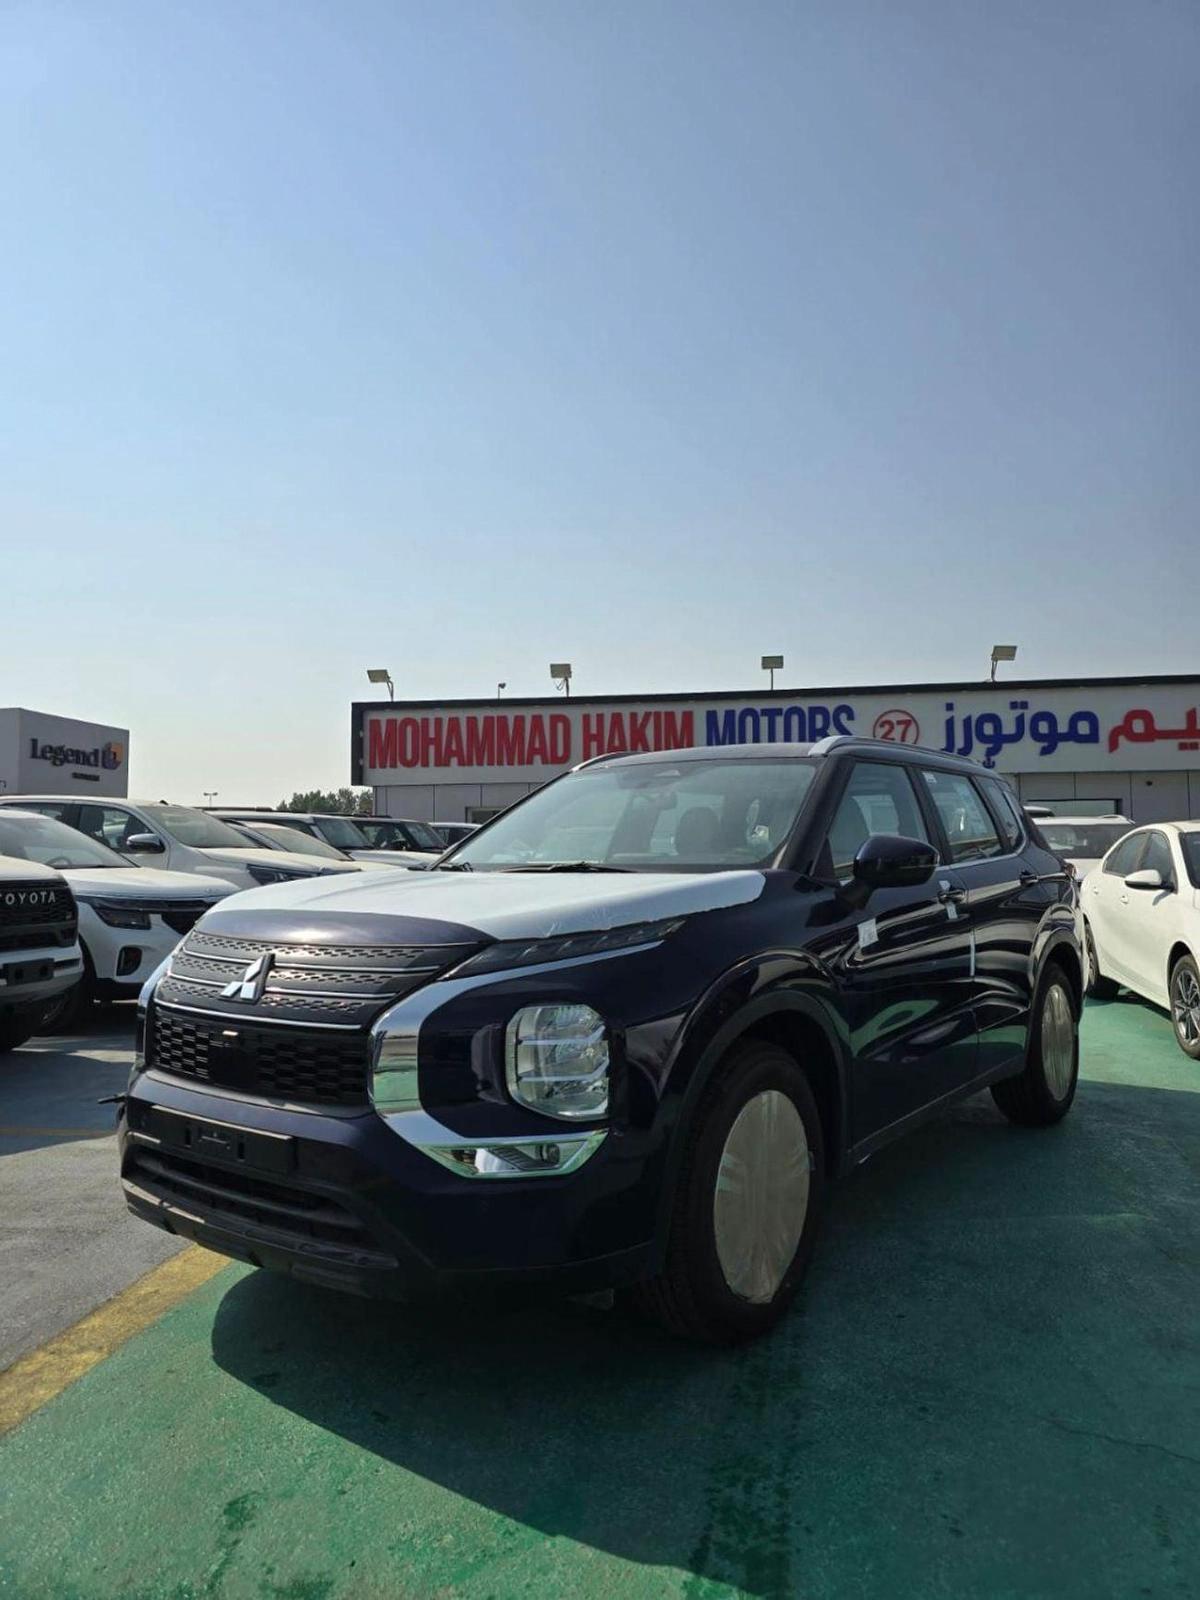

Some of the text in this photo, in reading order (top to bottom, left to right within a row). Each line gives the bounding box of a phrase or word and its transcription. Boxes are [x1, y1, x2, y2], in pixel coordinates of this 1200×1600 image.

[368, 704, 855, 768] MOHAMMAD HAKIM MOTORS
[879, 719, 912, 742] 27
[30, 738, 99, 767] Legend
[0, 891, 56, 905] OYOTA
